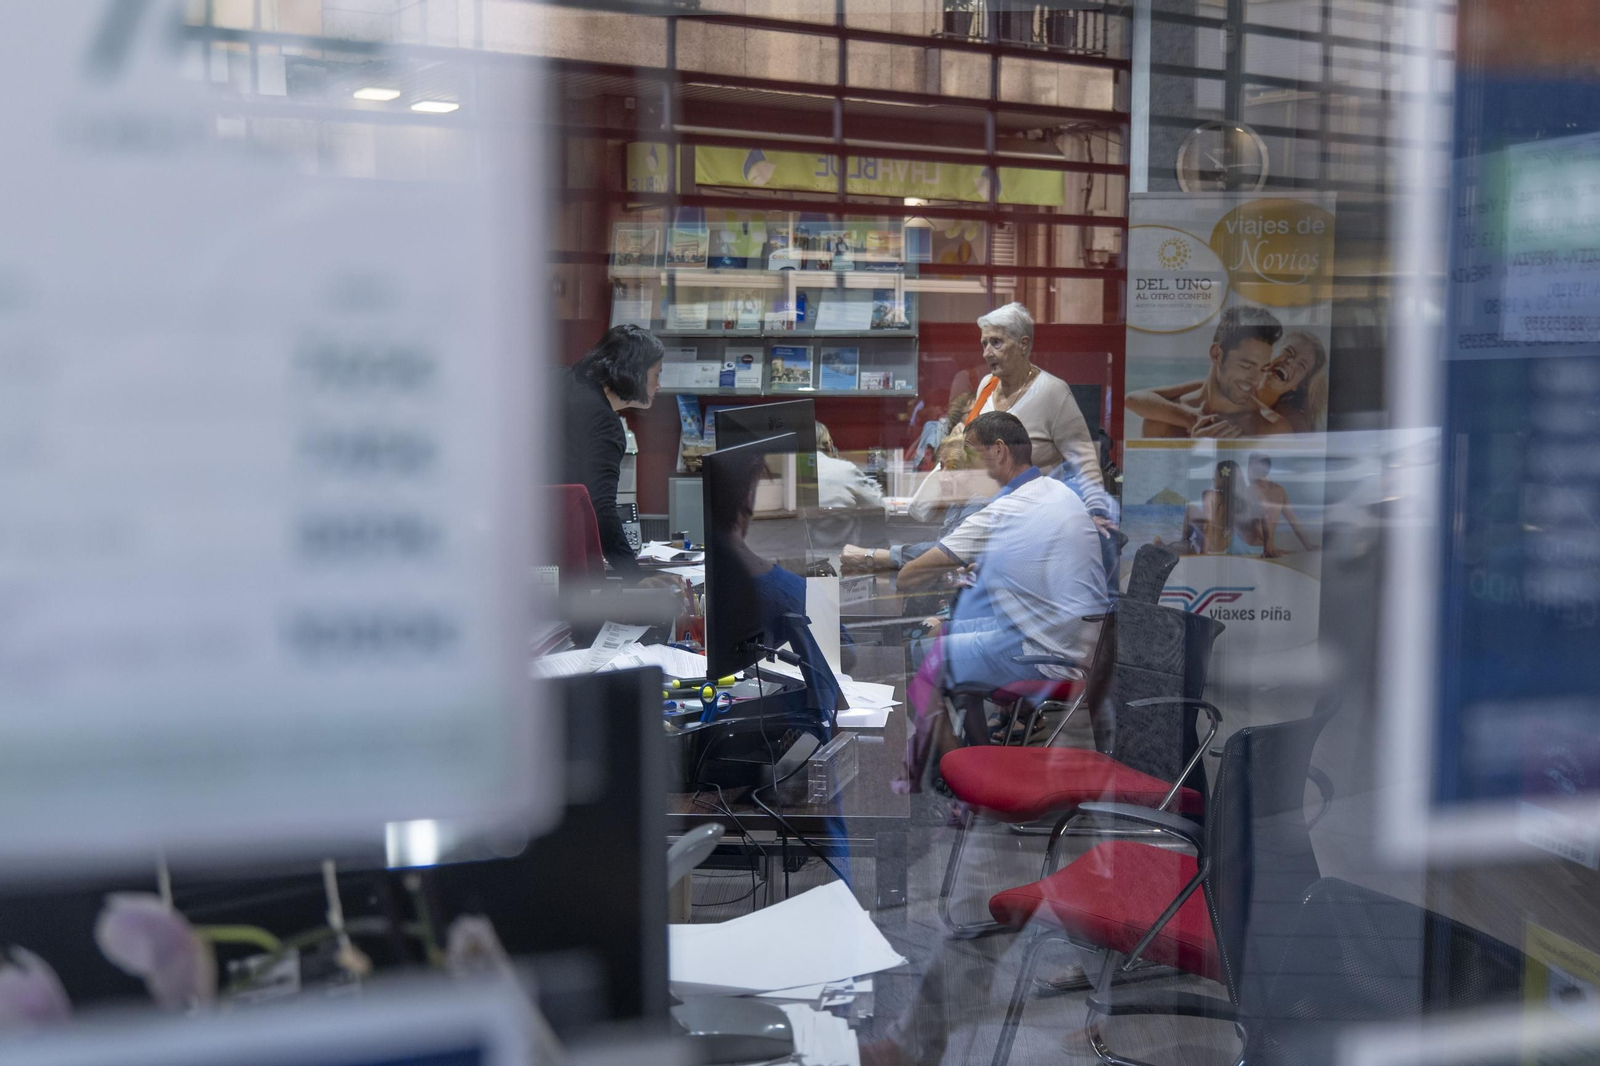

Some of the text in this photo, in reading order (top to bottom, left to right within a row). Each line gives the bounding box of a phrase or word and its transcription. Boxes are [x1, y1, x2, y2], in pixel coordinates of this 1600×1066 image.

[1225, 216, 1326, 239] viajes de
[1228, 239, 1320, 285] Novios
[1136, 278, 1212, 291] DEL UNO
[1177, 292, 1212, 300] CONFÍN
[1209, 606, 1256, 621] viaxes
